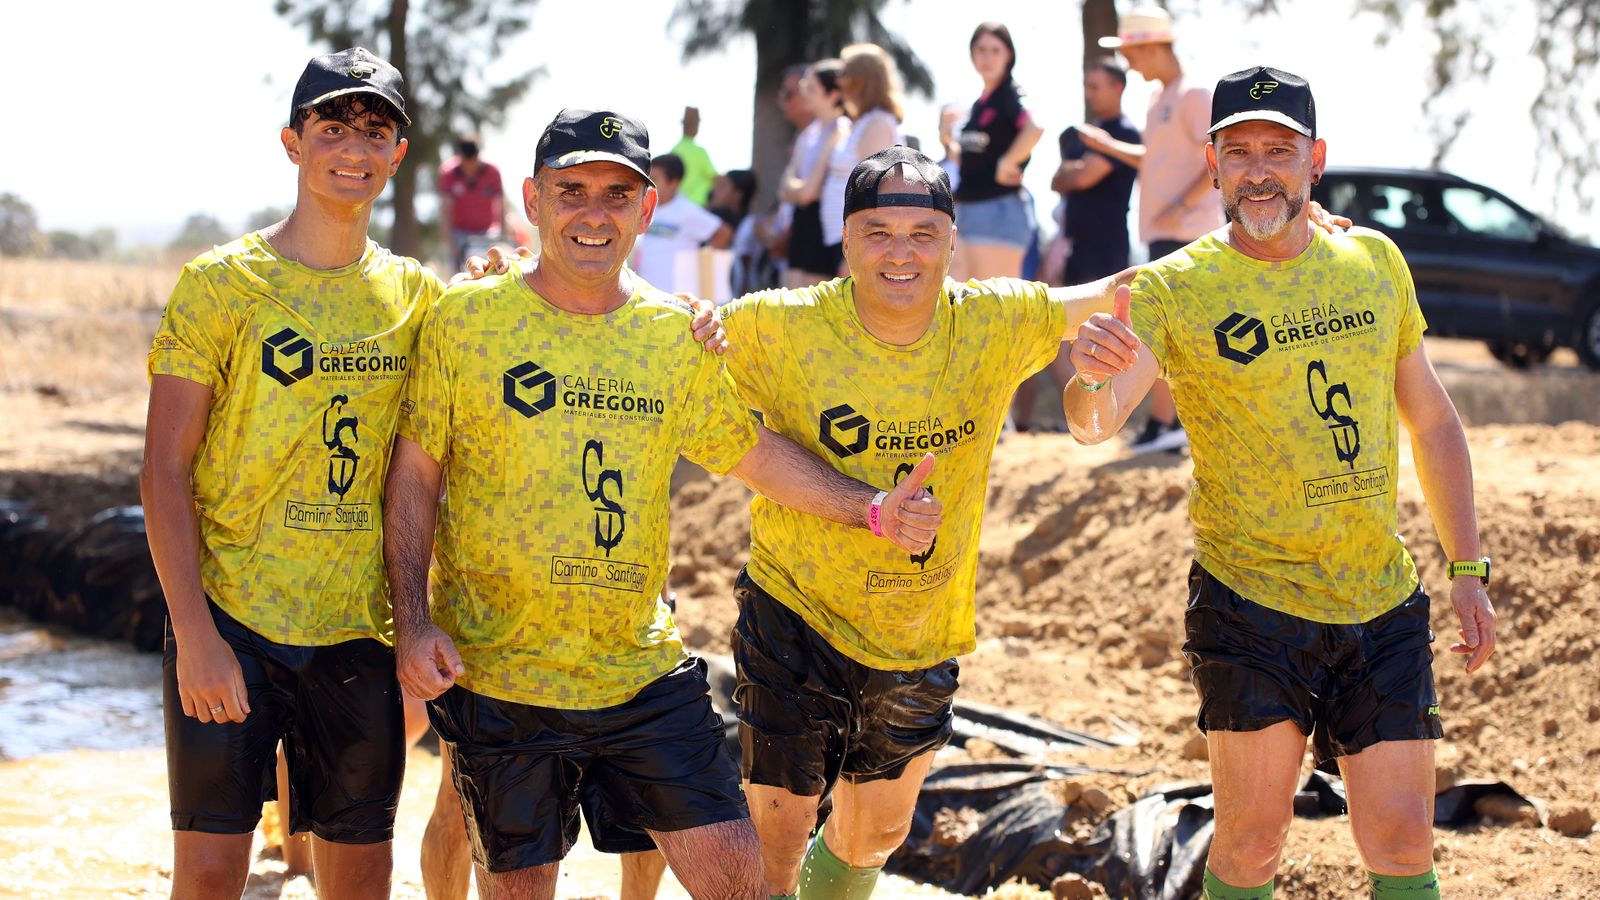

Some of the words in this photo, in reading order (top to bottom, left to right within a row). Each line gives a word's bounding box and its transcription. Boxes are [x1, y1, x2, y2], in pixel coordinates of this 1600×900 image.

[1270, 303, 1339, 328] CALERÍA
[1274, 309, 1375, 345] GREGORIO
[1278, 341, 1319, 352] MATERIALES
[1331, 327, 1378, 342] CONSTRUCCIÓN
[319, 355, 407, 373] GREGORIO
[563, 374, 636, 394] CALERÍA
[563, 390, 665, 415] GREGORIO
[563, 409, 606, 418] MATERIALES
[875, 419, 976, 450] GREGORIO
[876, 416, 944, 434] CALERÍA
[1307, 479, 1348, 499] Camino
[554, 559, 598, 578] Camino
[869, 574, 913, 588] Camino
